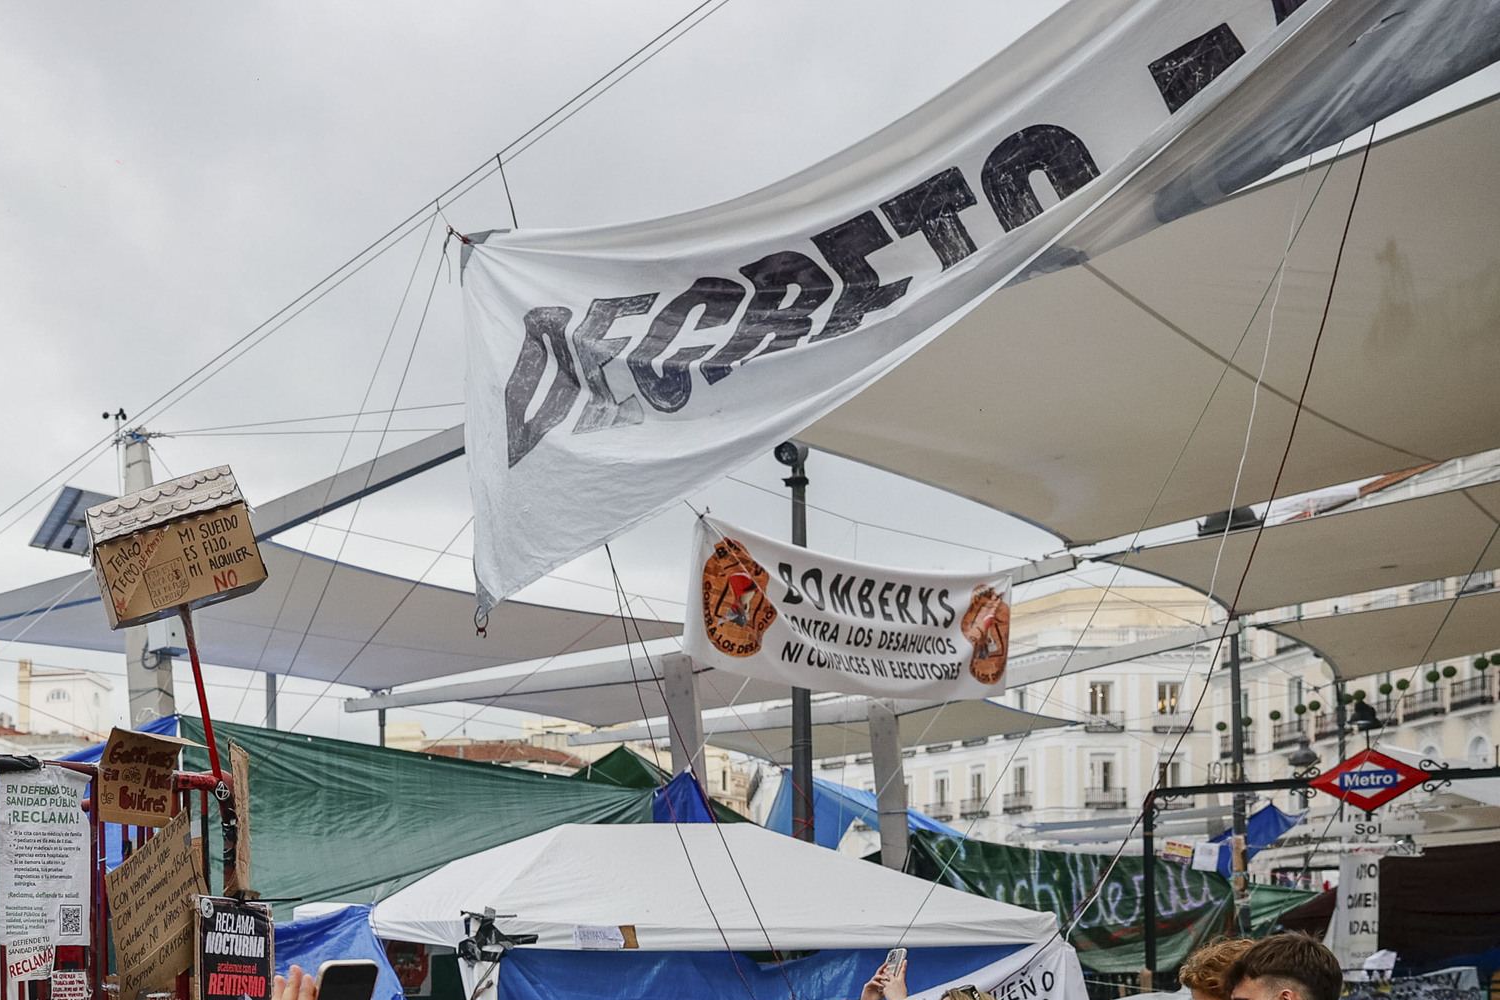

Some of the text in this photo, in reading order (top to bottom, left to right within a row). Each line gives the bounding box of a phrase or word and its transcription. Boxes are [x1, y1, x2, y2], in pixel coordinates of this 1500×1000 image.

[505, 123, 1102, 468] DECRETO
[178, 527, 195, 544] MI
[107, 541, 141, 574] TENGO
[189, 546, 253, 578] MI ALQUILER
[213, 569, 238, 592] NO
[778, 562, 956, 629] BOMBERXS
[785, 614, 956, 655] CONTRA LOS DESAHUCIOS
[781, 640, 802, 663] NI
[874, 657, 888, 677] NI
[891, 660, 962, 681] EJECUTORES
[1344, 772, 1393, 786] Metro
[8, 811, 80, 825] ¡RECLAMA!
[1355, 823, 1382, 834] Sol
[215, 912, 255, 933] RECLAMA
[205, 931, 266, 958] NOCTURNA
[8, 948, 54, 978] RECLAMA
[208, 972, 267, 998] RENTISMO
